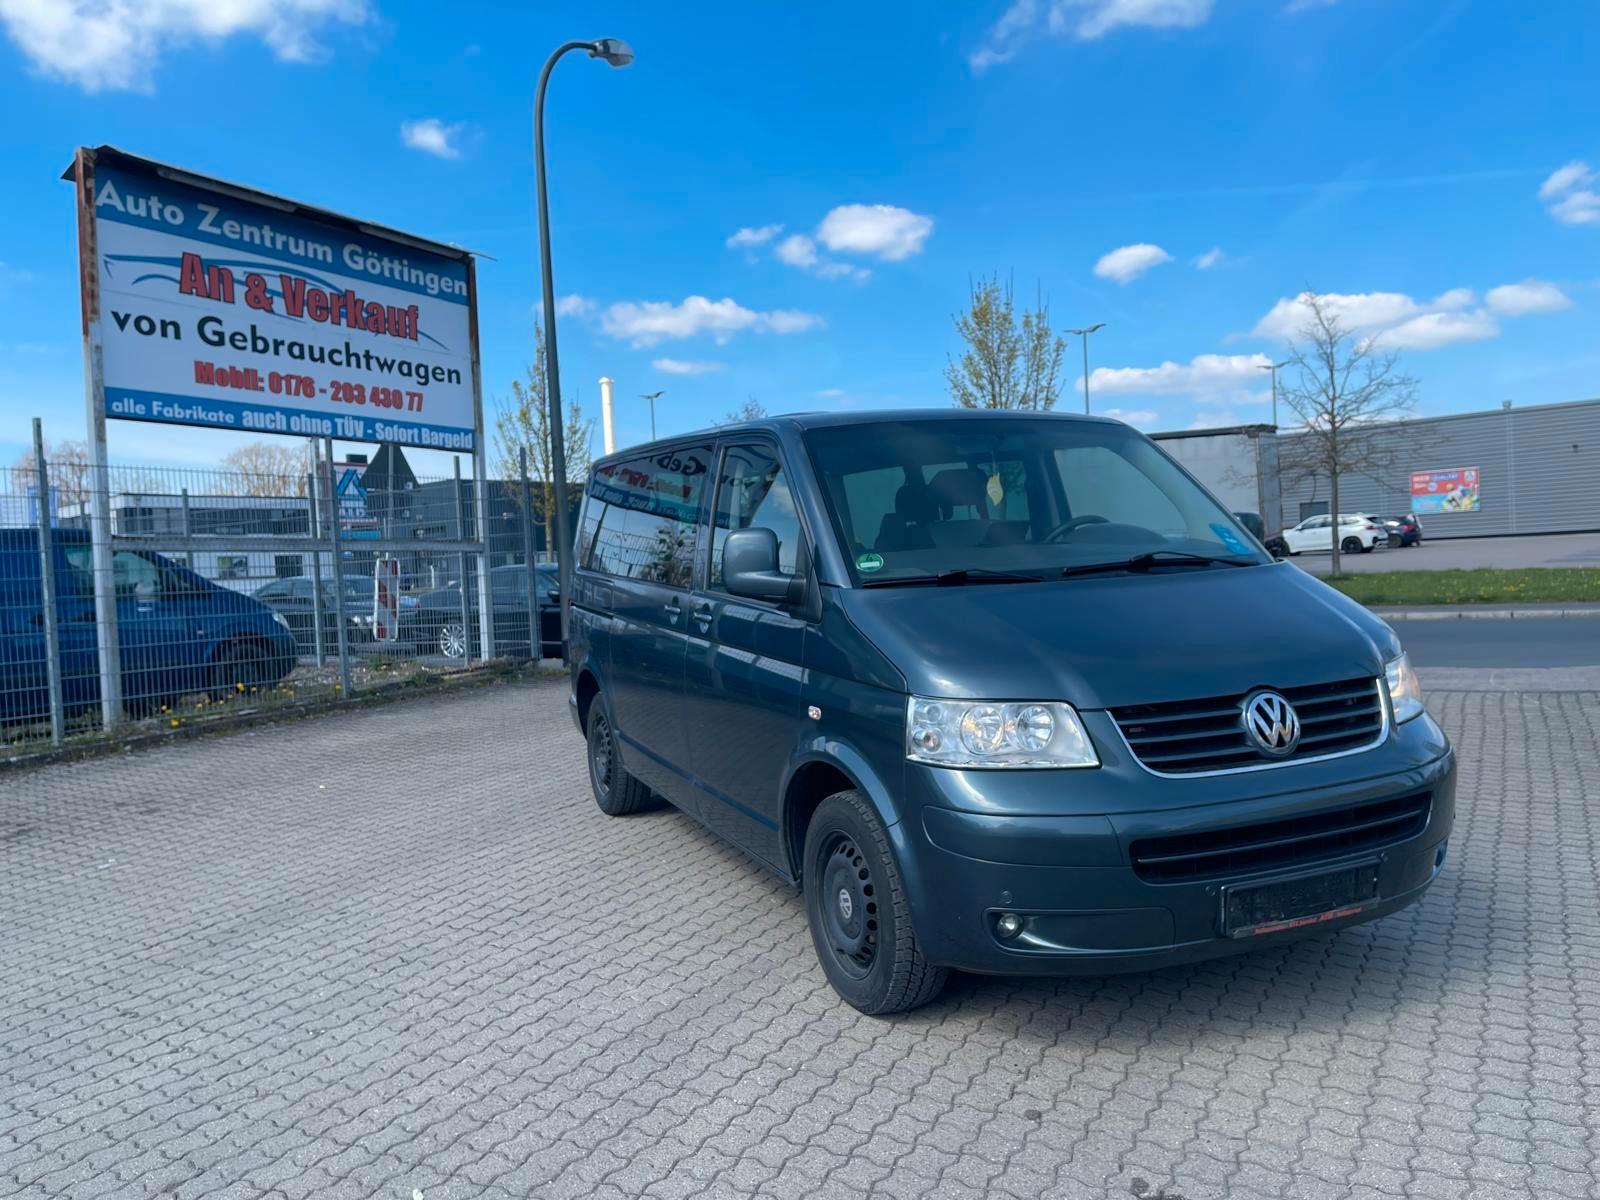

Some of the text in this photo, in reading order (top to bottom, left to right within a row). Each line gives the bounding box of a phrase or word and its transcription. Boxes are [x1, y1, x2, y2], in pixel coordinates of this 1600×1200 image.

[95, 179, 468, 296] Auto Zentrum Göttingen
[179, 251, 419, 341] An & Verkauf
[110, 310, 461, 386] von Gebrauchtwagen
[194, 360, 264, 392] Mobil:
[268, 371, 316, 398] 0176
[330, 380, 366, 405] 203
[369, 386, 403, 410] 430
[405, 391, 424, 412] 77
[112, 398, 146, 414] alle
[152, 400, 235, 423] Fabrikate
[241, 409, 287, 432] auch
[289, 413, 332, 435] ohne
[335, 416, 365, 438] TÜV
[375, 422, 420, 443] Sofort
[421, 427, 473, 448] Bargeld
